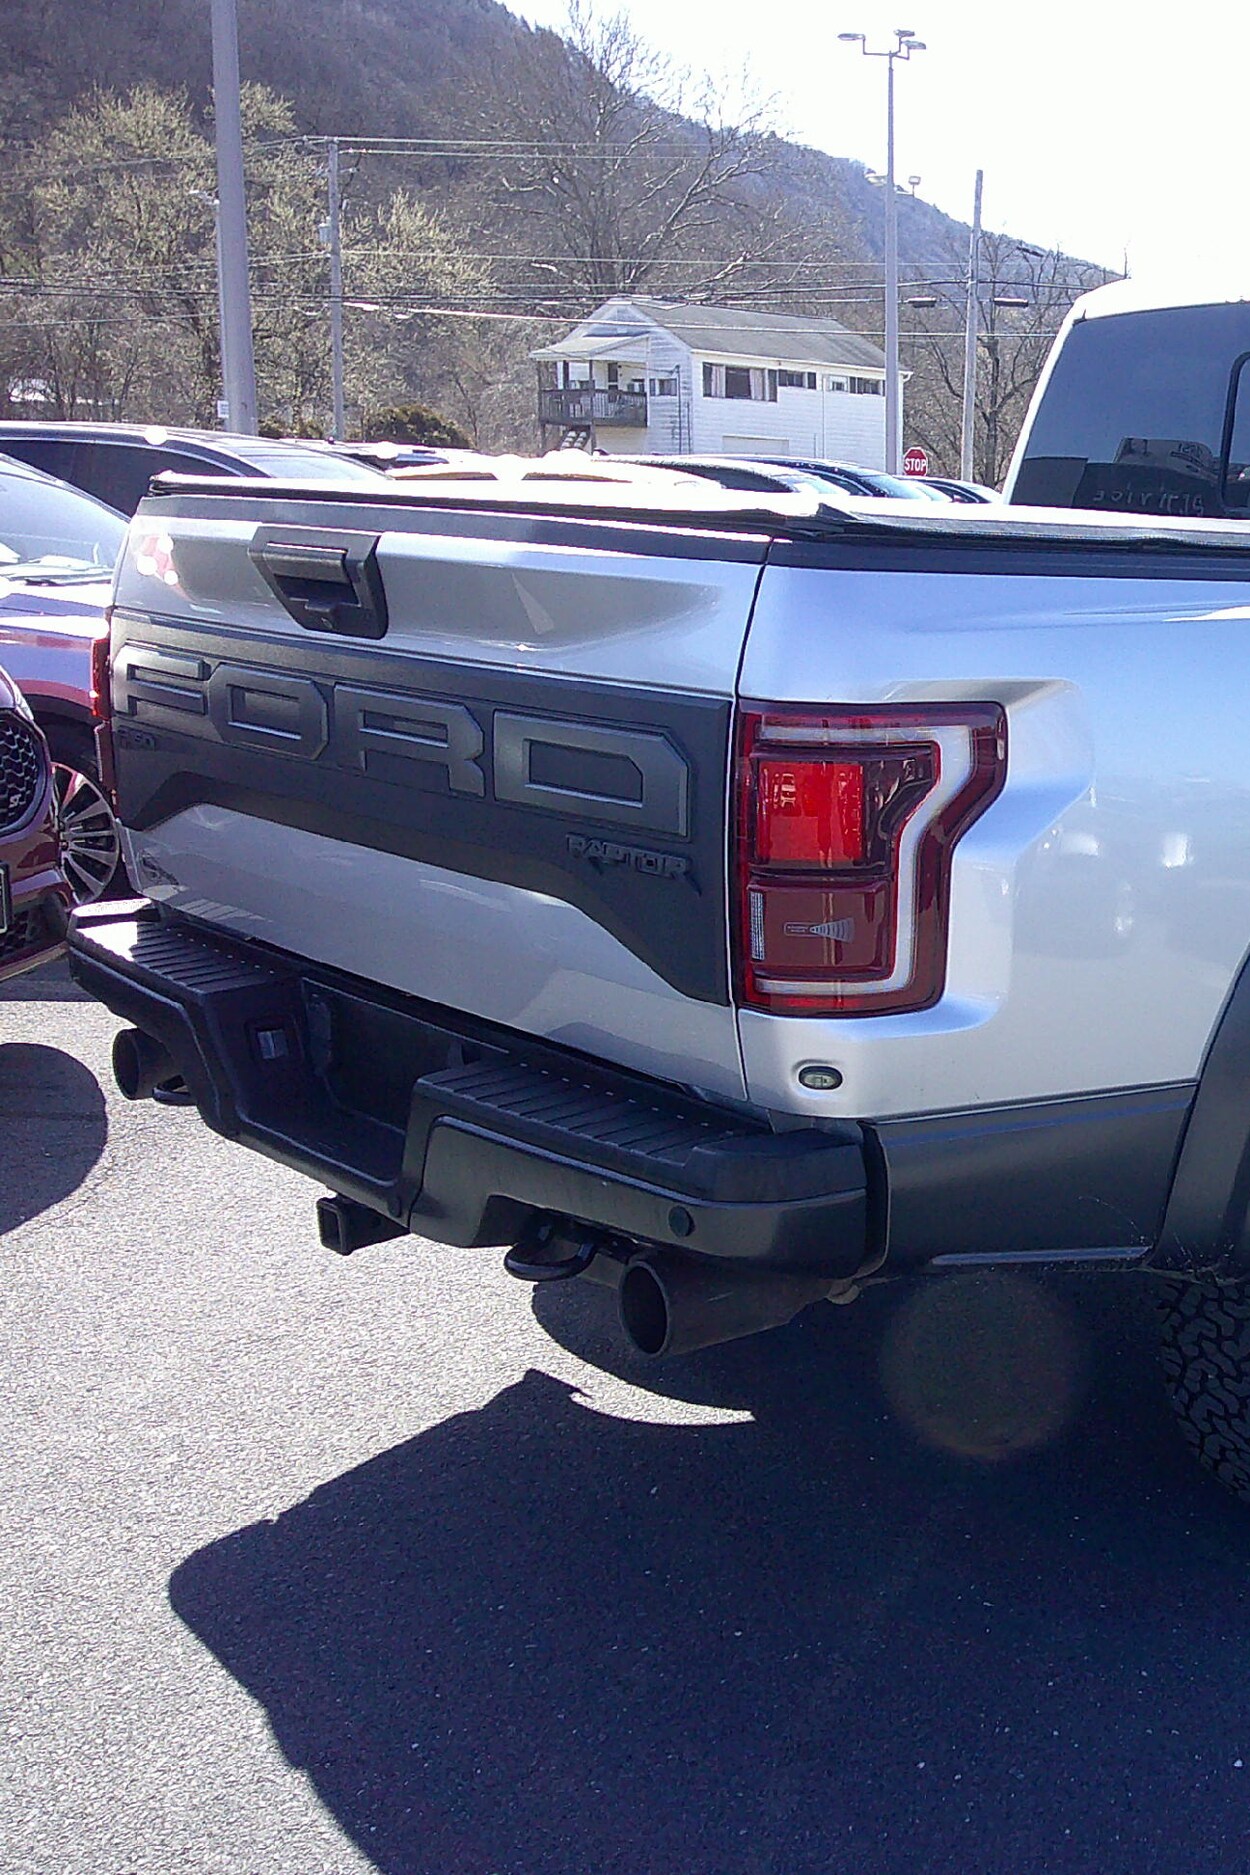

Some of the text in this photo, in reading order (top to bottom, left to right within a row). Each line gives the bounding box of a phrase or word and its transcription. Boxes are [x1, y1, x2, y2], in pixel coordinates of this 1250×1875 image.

[904, 459, 926, 471] STOP
[113, 645, 689, 837] FORD
[566, 833, 691, 881] RAPTOR
